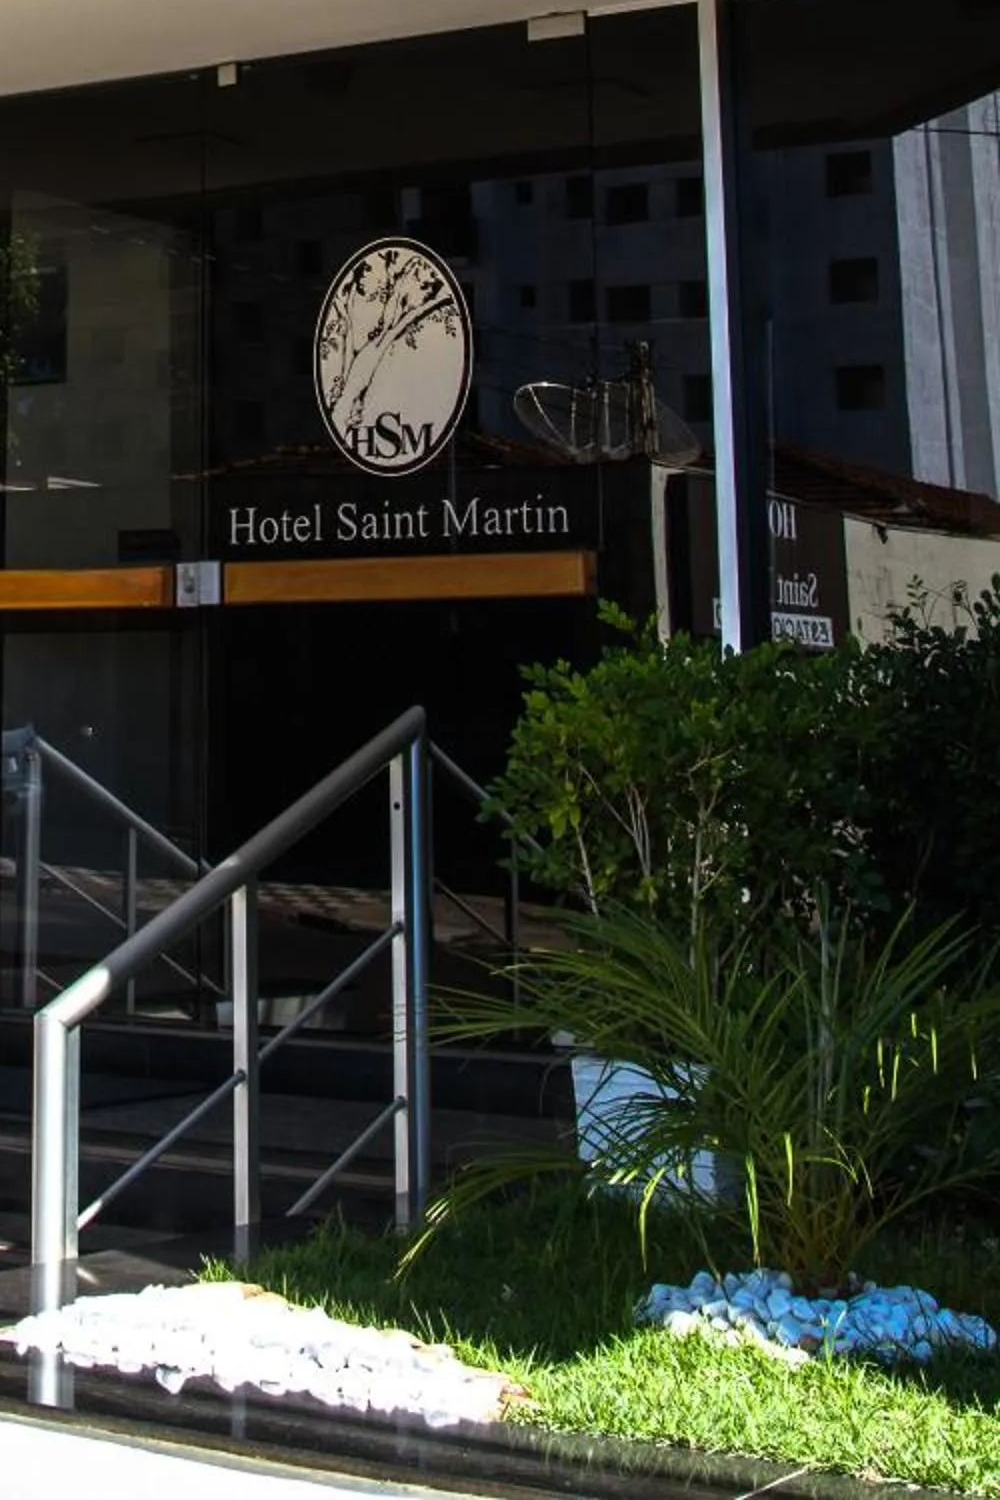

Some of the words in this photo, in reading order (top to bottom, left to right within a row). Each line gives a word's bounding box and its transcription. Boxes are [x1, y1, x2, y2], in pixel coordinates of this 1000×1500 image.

[350, 412, 434, 459] HSM
[228, 503, 323, 545] Hotel
[336, 500, 429, 541] Saint
[442, 494, 570, 538] Martin
